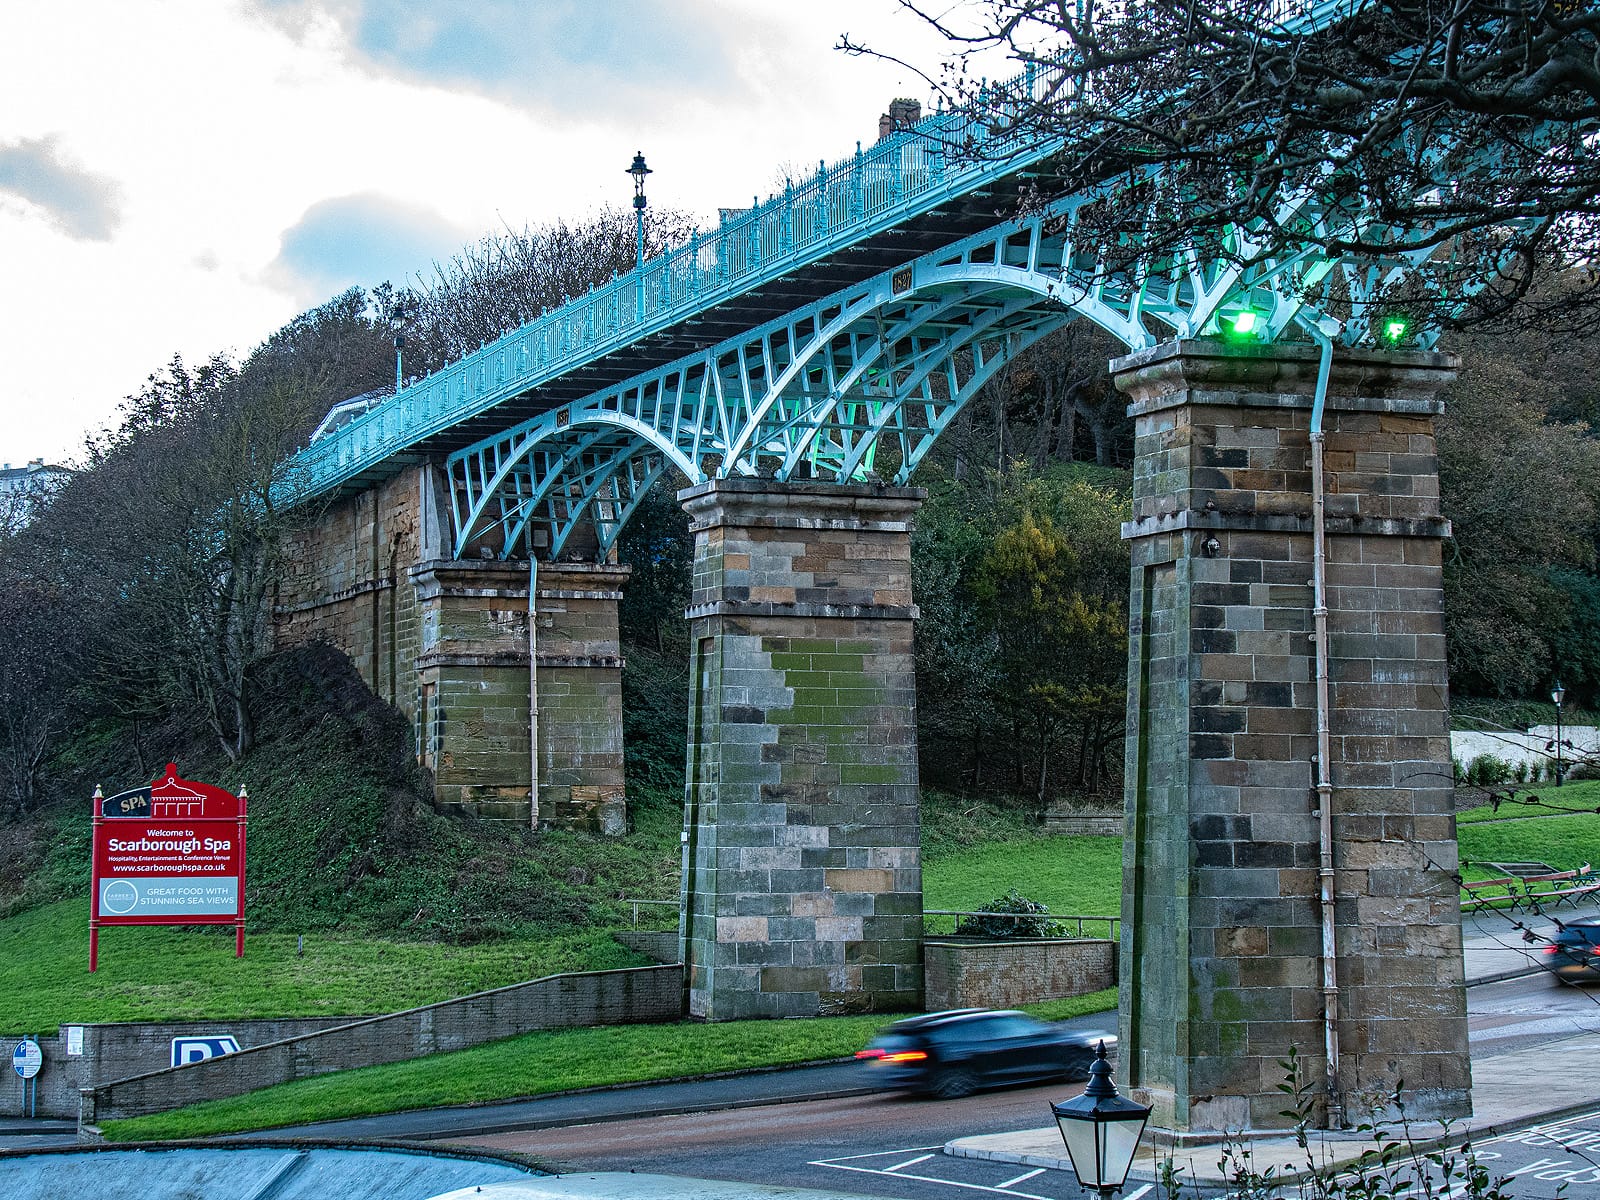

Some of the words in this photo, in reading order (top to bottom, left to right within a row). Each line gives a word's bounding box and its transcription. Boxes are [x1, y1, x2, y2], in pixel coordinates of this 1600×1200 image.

[894, 271, 912, 291] 1827
[120, 795, 147, 813] SPA
[147, 829, 184, 837] Welcome
[185, 829, 194, 837] to
[108, 837, 201, 854] Scarborough
[204, 837, 231, 854] Spa
[113, 863, 225, 873] www.scarboroughspa.co.uk
[147, 888, 175, 896] GREAT
[178, 887, 204, 895] FOOD
[206, 887, 229, 895] WITH
[140, 897, 185, 905] STUNNING
[187, 896, 204, 904] SEA
[206, 896, 235, 904] VIEWS
[20, 1044, 26, 1053] P
